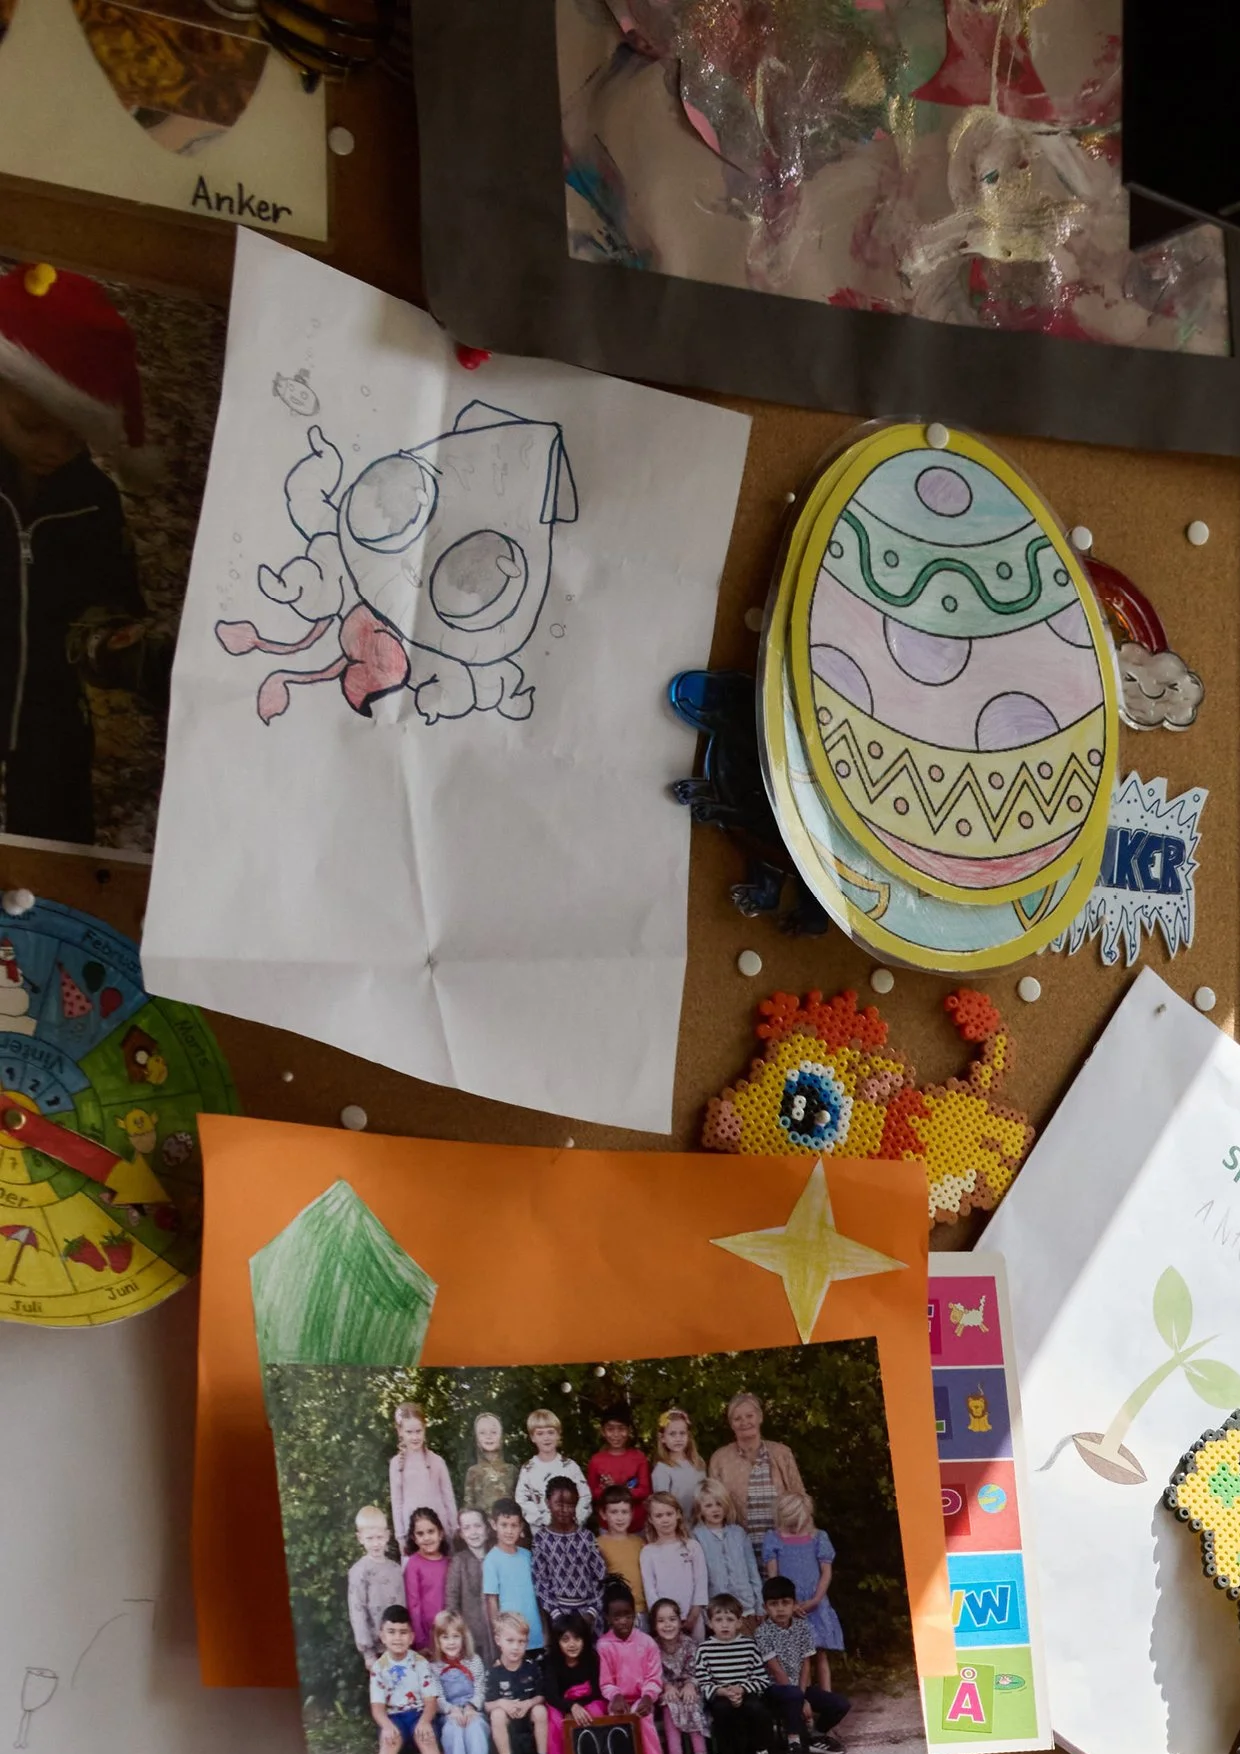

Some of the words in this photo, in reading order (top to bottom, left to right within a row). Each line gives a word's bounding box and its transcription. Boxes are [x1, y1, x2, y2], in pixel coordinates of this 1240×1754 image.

[191, 174, 293, 223] Anker
[174, 1018, 211, 1068] Marts
[10, 1301, 43, 1314] Juli
[104, 1281, 140, 1302] Juni
[946, 1667, 986, 1724] Å
